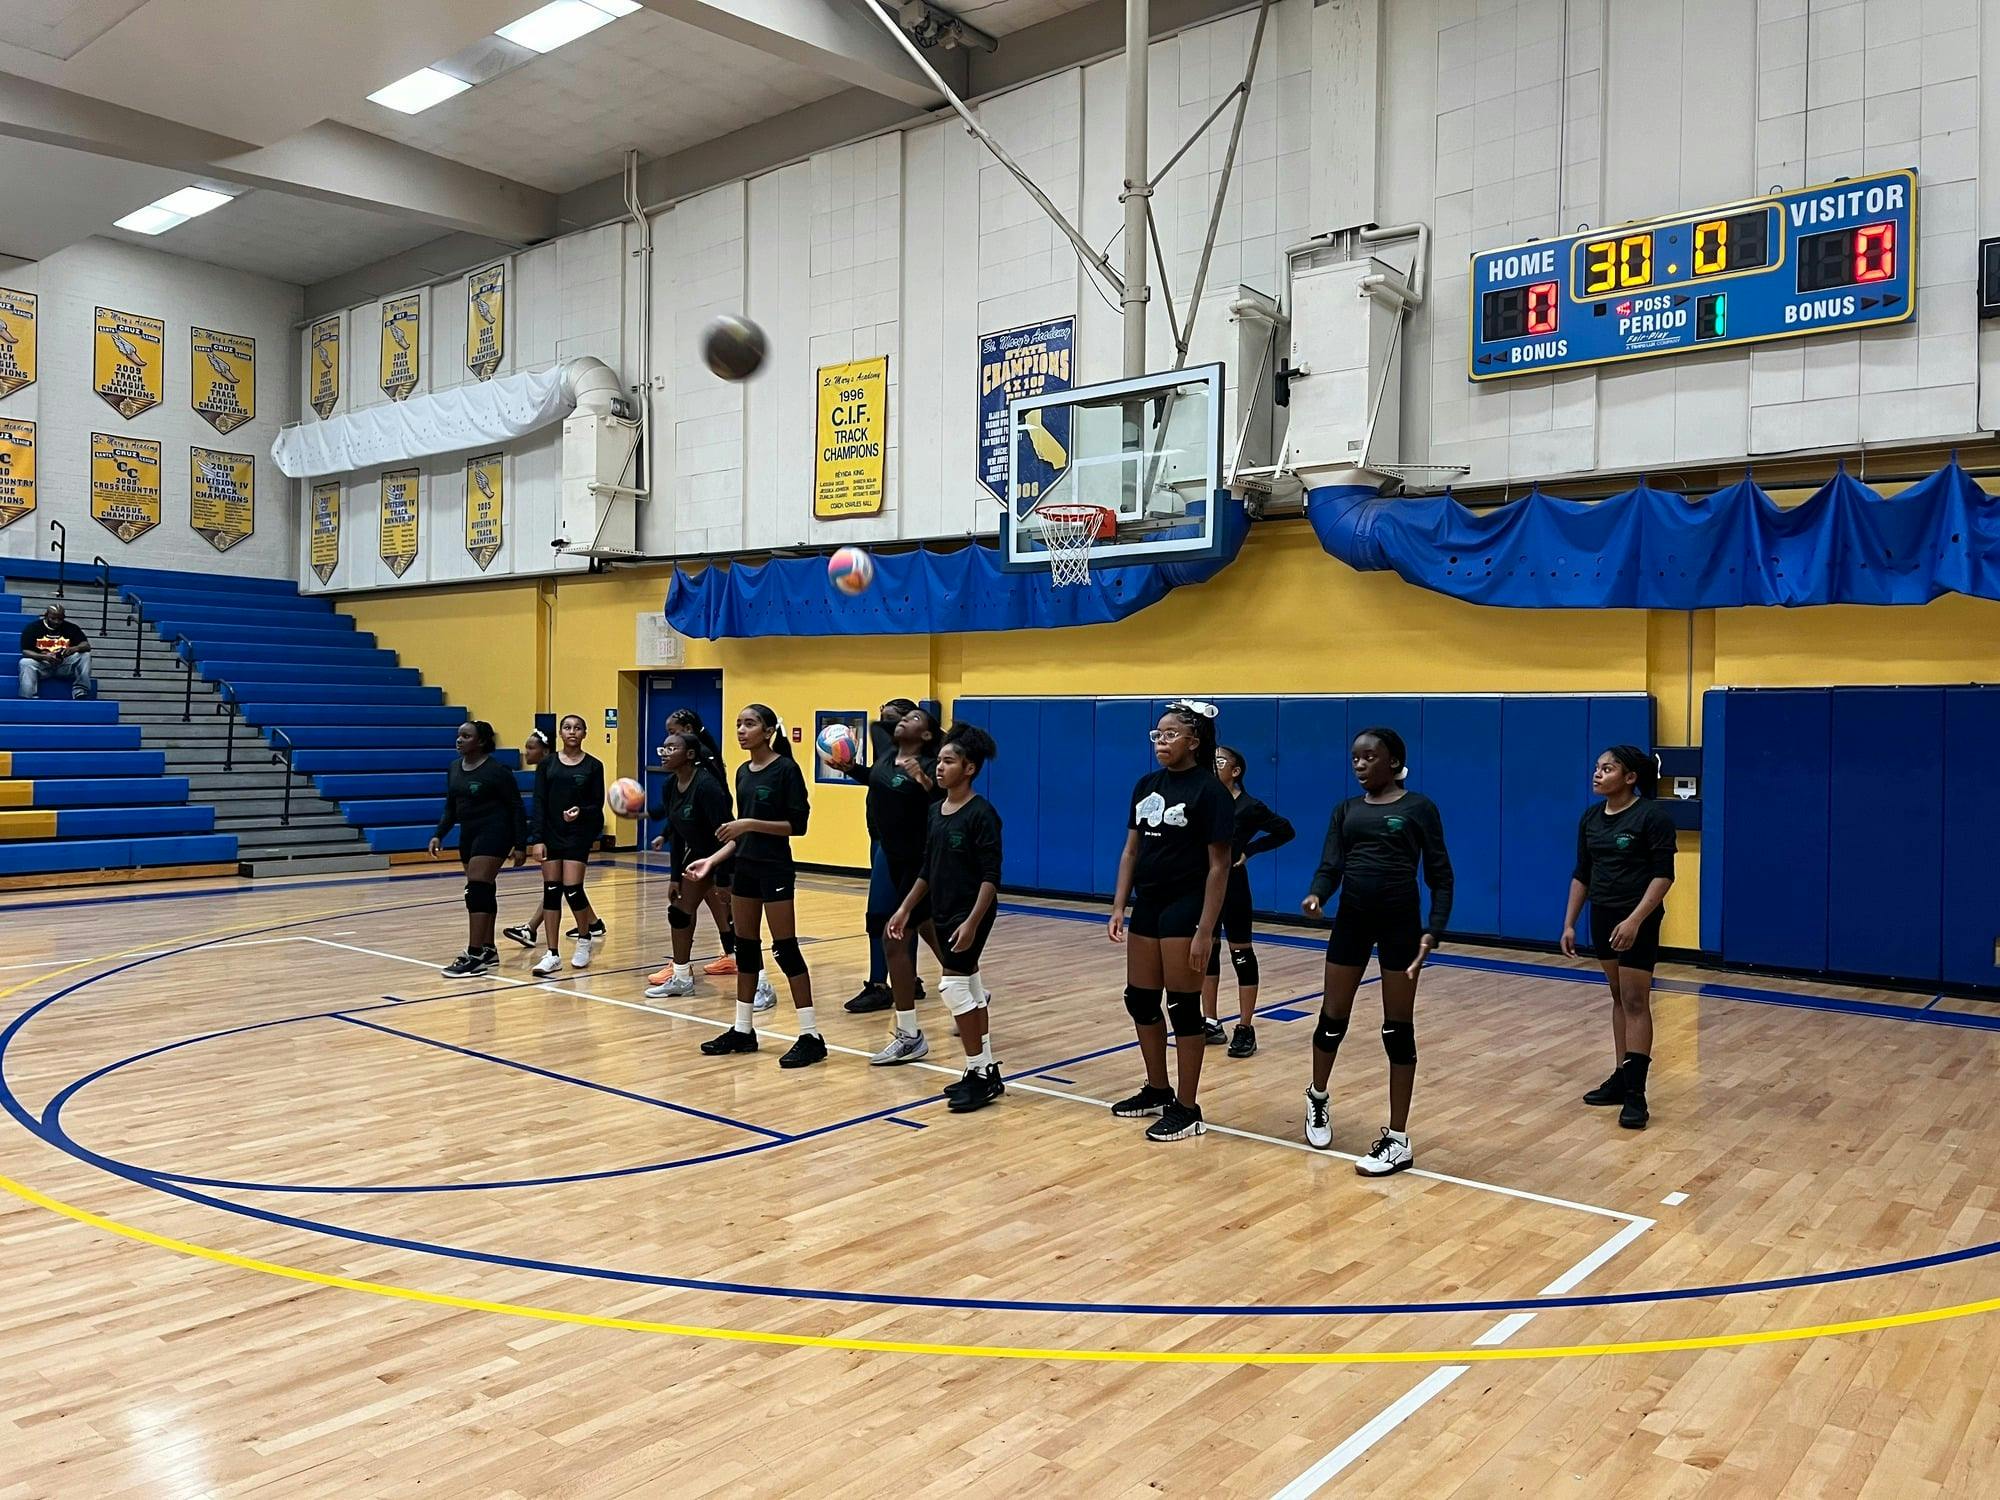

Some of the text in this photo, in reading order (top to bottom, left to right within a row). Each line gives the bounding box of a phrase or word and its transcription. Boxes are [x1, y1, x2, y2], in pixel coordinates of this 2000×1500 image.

[1790, 184, 1904, 226] VISITOR
[1854, 224, 1893, 283] 0
[1488, 249, 1555, 282] HOME
[1527, 282, 1557, 334] 0
[1635, 295, 1671, 313] POSS
[1785, 296, 1855, 324] BONUS
[1715, 295, 1724, 335] 1
[1619, 310, 1687, 335] PERIOD
[118, 325, 142, 334] CRUZ
[1031, 326, 1071, 345] Academy
[0, 344, 13, 352] 10
[213, 344, 235, 353] CRUZ
[1005, 343, 1047, 361] STATE
[1511, 339, 1568, 364] BONUS
[0, 353, 14, 361] ACK
[472, 349, 499, 363] CHAMPIONS
[0, 361, 18, 370] GUE
[116, 364, 142, 375] 2009
[0, 367, 28, 379] PIONS
[114, 372, 143, 383] TRACK
[834, 375, 854, 385] Mary's
[856, 372, 881, 382] Academy
[982, 348, 1069, 397] CHAMPIONS
[111, 378, 146, 391] LEAGUE
[385, 374, 415, 385] CHAMPIONS
[1024, 375, 1045, 389] 100
[101, 384, 155, 400] CHAMPIONS
[210, 389, 237, 400] TRACK
[839, 388, 864, 403] 1996
[207, 396, 240, 407] LEAGUE
[198, 401, 248, 416] CHAMPIONS
[831, 404, 871, 427] C.I.F.
[834, 427, 868, 445] TRACK
[115, 449, 139, 458] CRUZ
[823, 443, 879, 462] CHAMPIONS
[993, 447, 1008, 456] COACHE
[0, 478, 34, 487] OUNTRY
[93, 481, 159, 496] CROSS COUNTRY
[195, 477, 249, 490] DIVISION IV
[0, 487, 16, 495] GUE
[195, 491, 249, 504] CHAMPIONS
[207, 486, 238, 496] TRACK
[101, 511, 152, 522] CHAMPIONS
[110, 505, 143, 515] LEAGUE
[470, 535, 498, 546] CHAMPIONS
